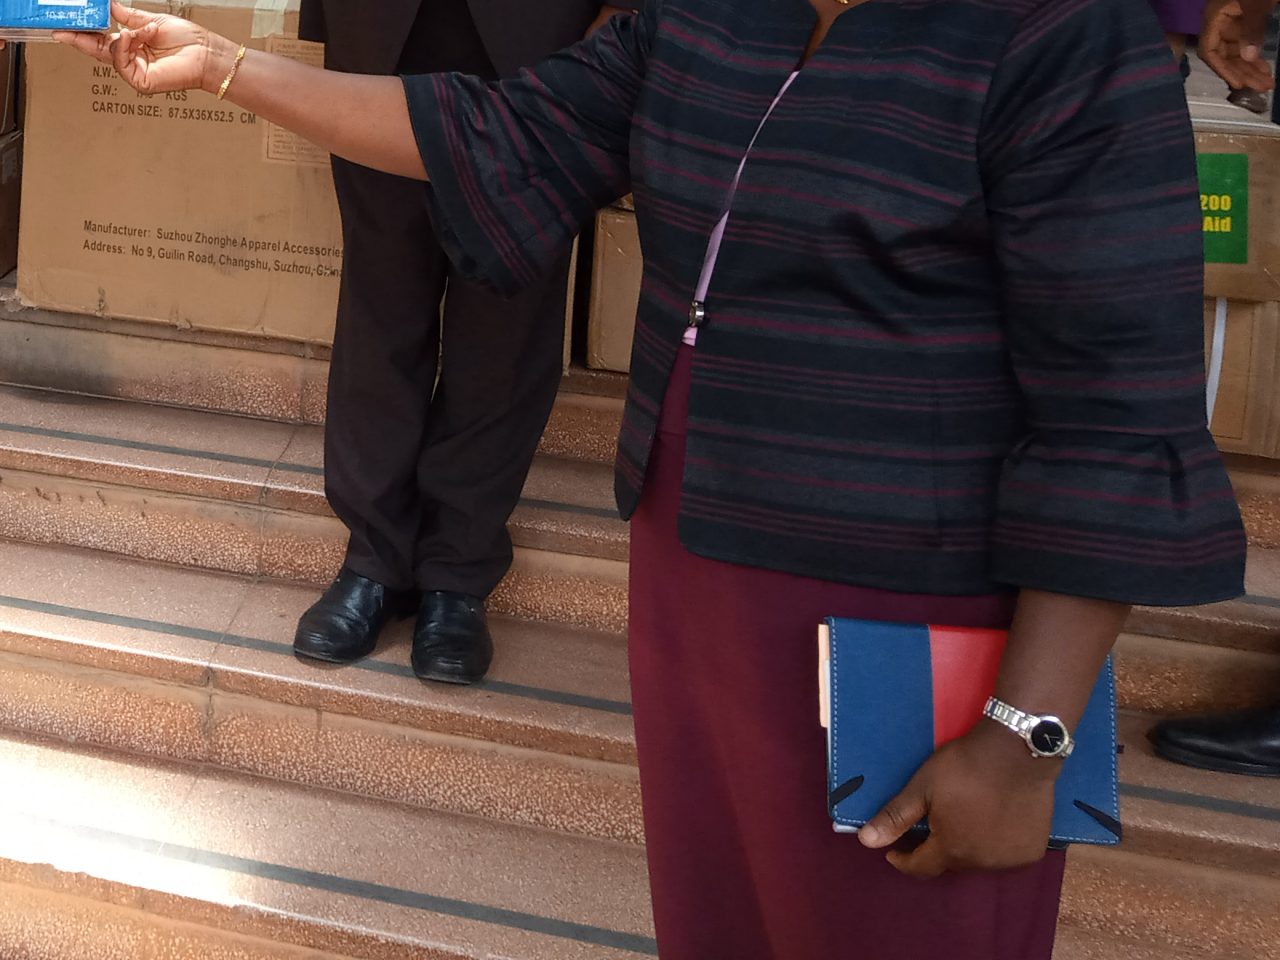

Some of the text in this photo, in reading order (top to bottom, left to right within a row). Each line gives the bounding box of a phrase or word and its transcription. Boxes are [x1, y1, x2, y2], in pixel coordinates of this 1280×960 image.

[92, 101, 135, 115] CARTON
[137, 105, 163, 118] SIZE:
[240, 112, 256, 124] CM
[84, 220, 151, 238] Manufacturer:
[156, 228, 192, 243] Suzhou
[195, 232, 238, 249] Zhonghe
[240, 237, 281, 253] Apparel
[1202, 216, 1232, 232] Aid
[83, 240, 126, 255] Address:
[131, 245, 145, 257] No
[158, 248, 185, 262] Guilin
[188, 251, 216, 266] Road,
[219, 254, 271, 272] Changshu,
